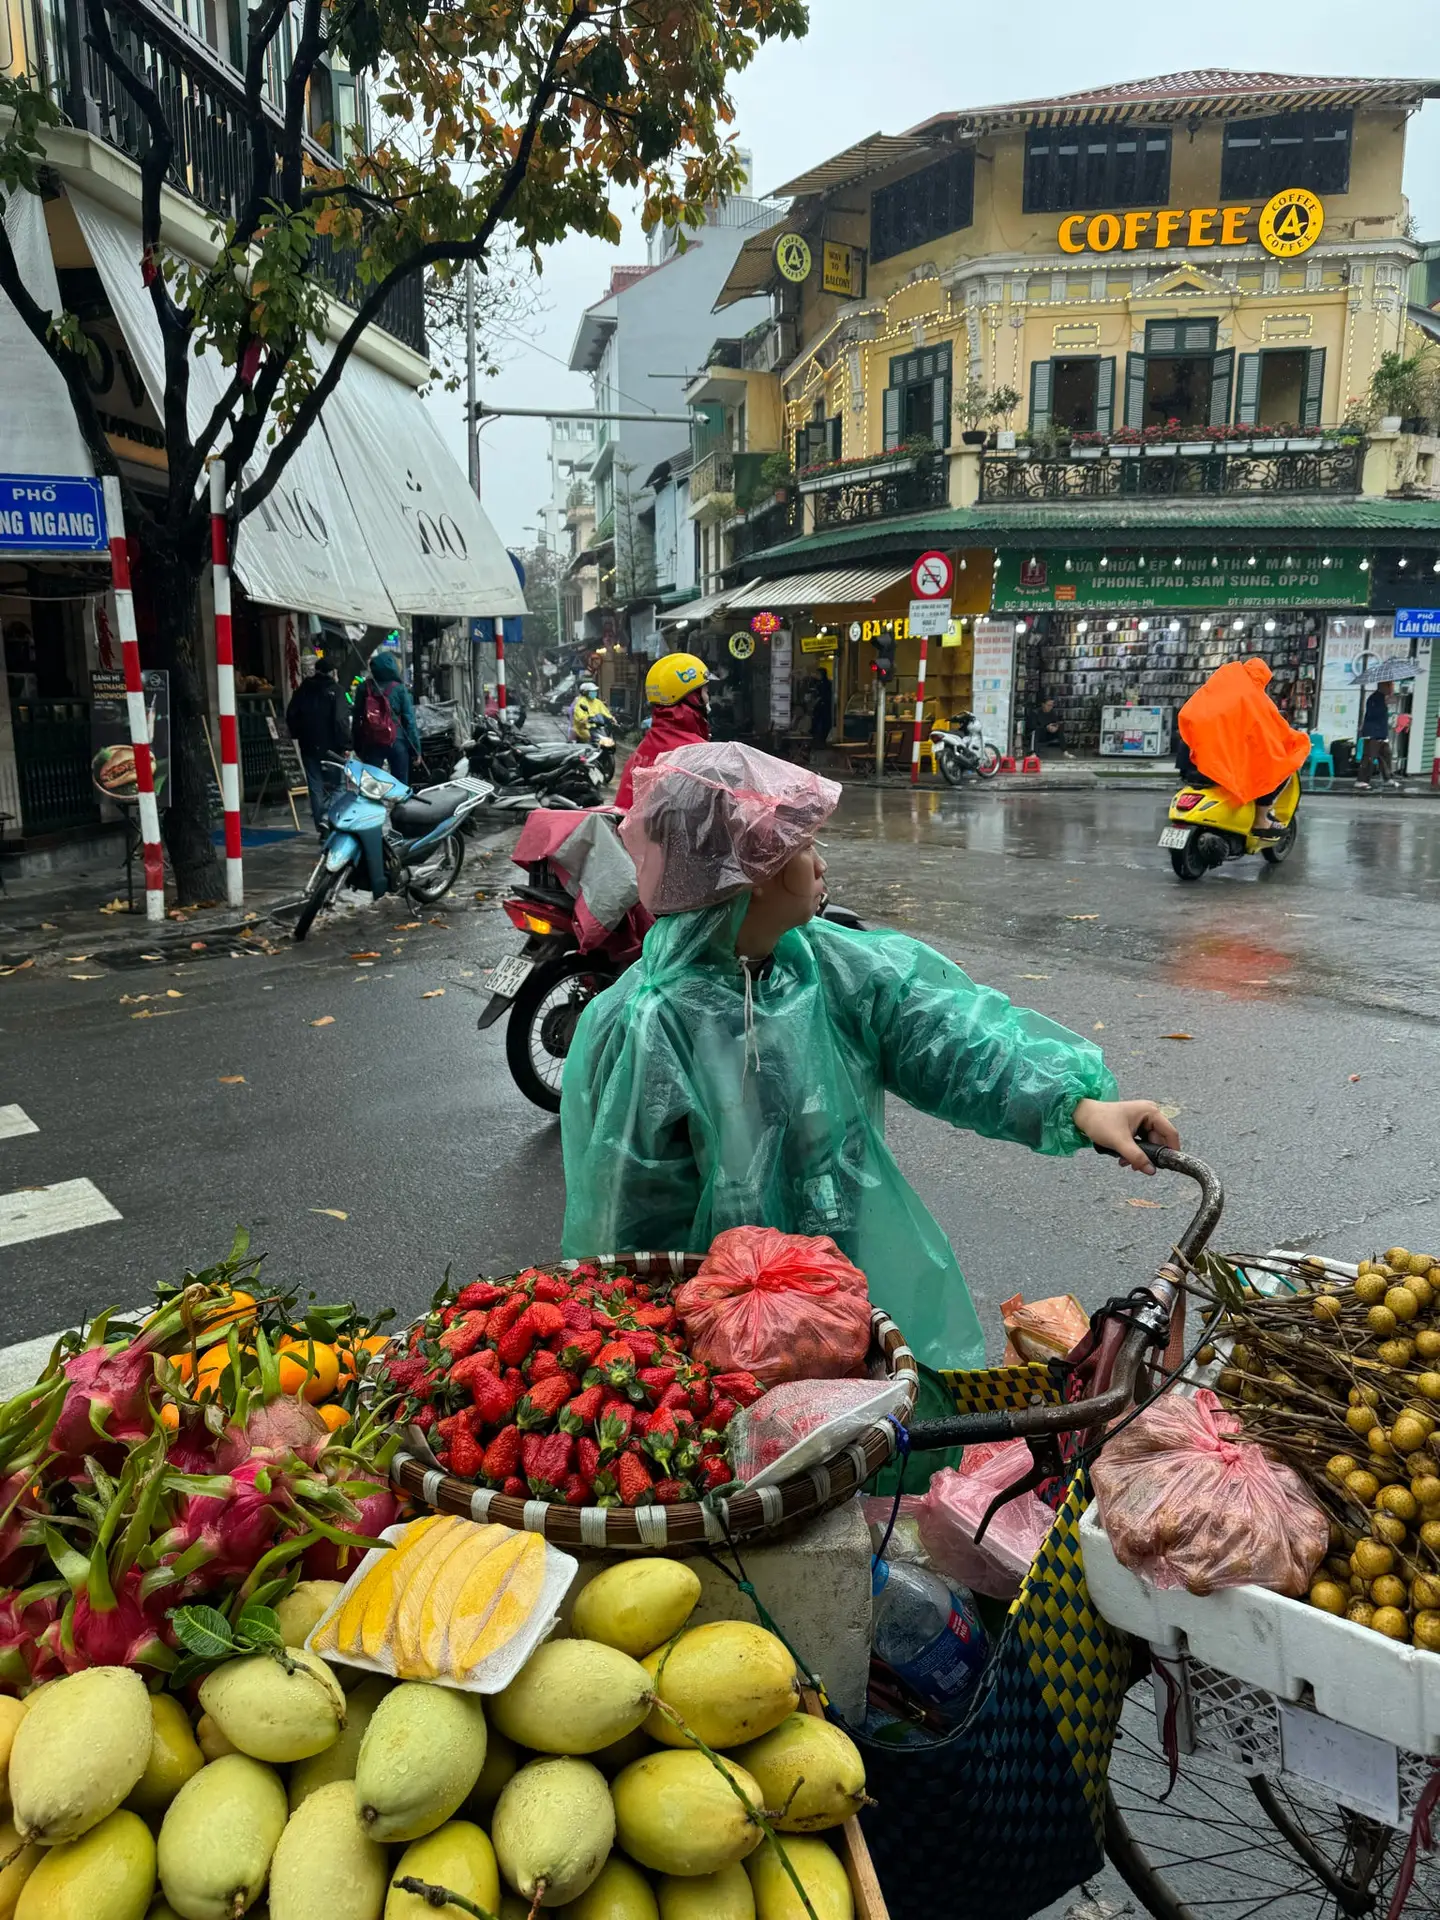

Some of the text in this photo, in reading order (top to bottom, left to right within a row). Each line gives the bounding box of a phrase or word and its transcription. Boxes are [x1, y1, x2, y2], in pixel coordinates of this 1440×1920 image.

[1271, 193, 1318, 213] COFFEE
[1276, 204, 1308, 238] A
[1057, 206, 1252, 254] COFFEE
[782, 236, 807, 252] COFFEE
[1265, 233, 1313, 252] COFFEE
[782, 263, 807, 279] COFFEE
[831, 262, 839, 271] TO
[825, 274, 850, 289] BALCONY
[12, 484, 57, 502] PHỐ
[29, 511, 96, 537] NGANG
[1192, 575, 1224, 587] SAM
[1278, 575, 1319, 587] OPPO
[1142, 598, 1155, 607] HN
[1416, 611, 1434, 620] PHỐ
[675, 667, 697, 684] be
